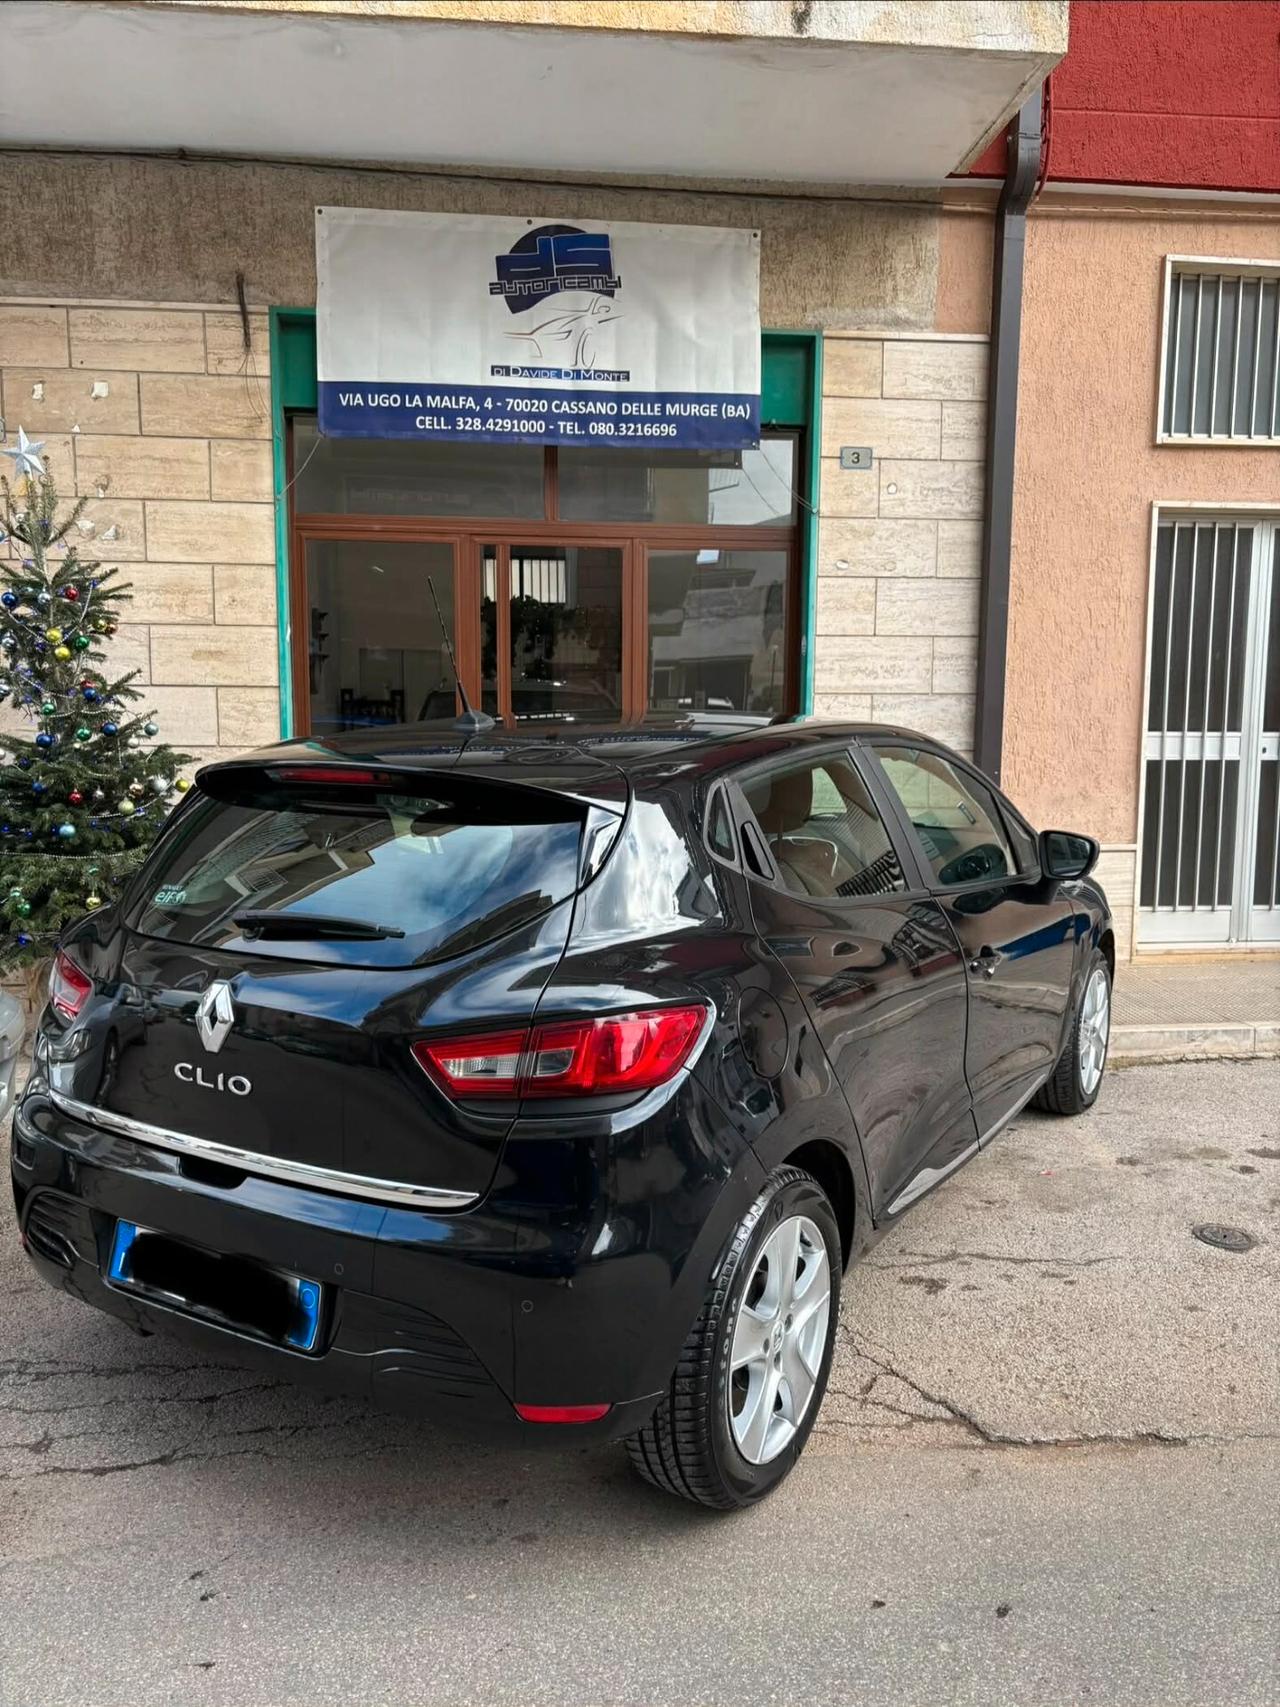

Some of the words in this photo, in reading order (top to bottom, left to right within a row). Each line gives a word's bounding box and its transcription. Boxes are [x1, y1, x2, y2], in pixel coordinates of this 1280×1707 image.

[580, 369, 628, 381] MONTE
[339, 393, 364, 407] VIA
[368, 393, 401, 408] UGO
[405, 394, 423, 408] LA
[426, 395, 480, 412] MALFA,
[483, 397, 493, 411] 4
[505, 398, 548, 413] 70020
[551, 400, 618, 414] CASSANO
[621, 402, 662, 416] DELLE
[665, 403, 718, 417] MURGE
[721, 402, 750, 420] (BA)
[415, 416, 451, 430] CELL.
[455, 417, 546, 433] 328.4291000
[557, 421, 585, 435] TEL.
[589, 422, 677, 437] 080.3216696
[851, 451, 861, 465] 3
[173, 1062, 252, 1096] CLIO
